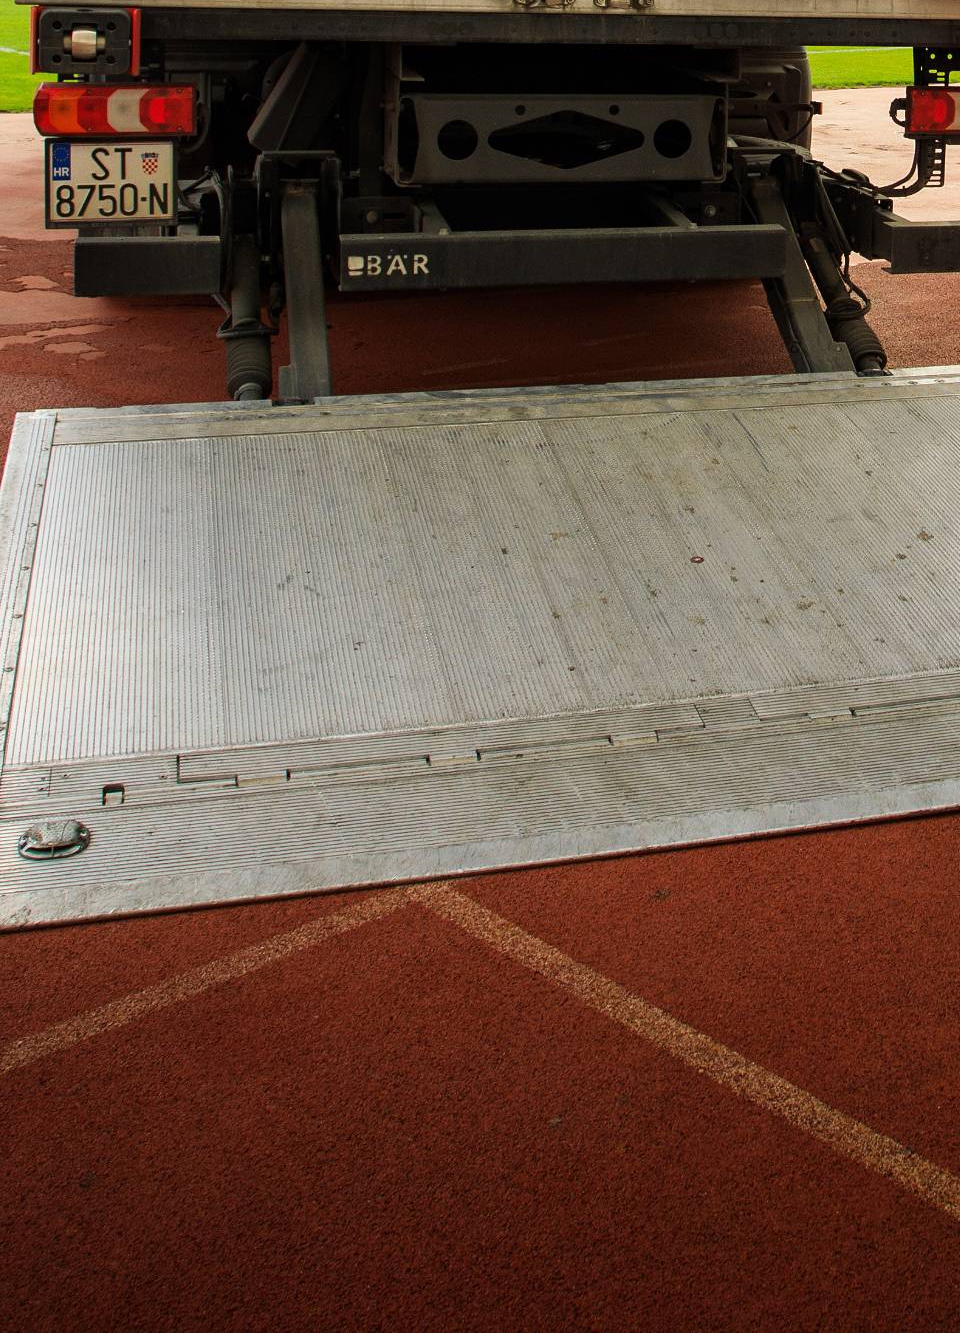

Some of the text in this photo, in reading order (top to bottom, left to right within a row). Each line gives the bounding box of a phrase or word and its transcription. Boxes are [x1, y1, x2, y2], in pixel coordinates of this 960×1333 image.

[53, 167, 70, 177] HR
[91, 147, 133, 181] ST
[56, 182, 168, 218] 8750-N
